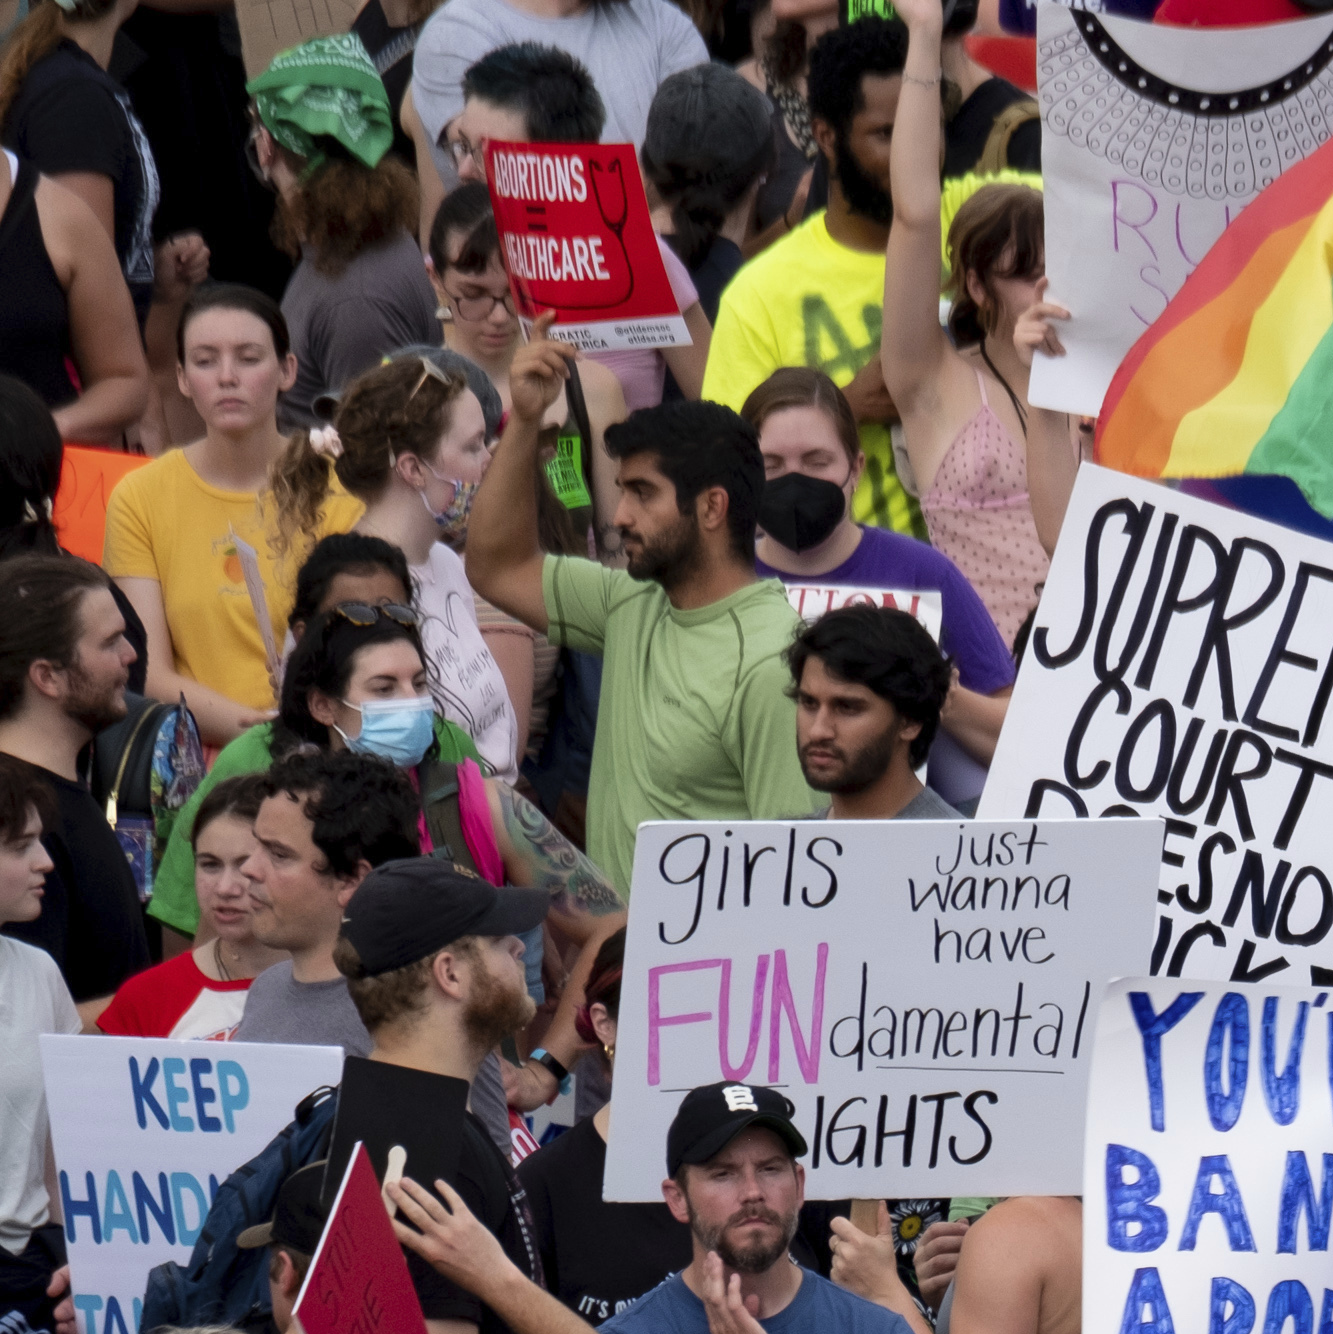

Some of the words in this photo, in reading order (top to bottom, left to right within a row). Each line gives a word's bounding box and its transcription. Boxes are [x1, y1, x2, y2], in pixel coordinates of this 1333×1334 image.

[493, 152, 588, 203] ABORTIONS
[503, 231, 611, 282] HEALTHCARE
[657, 828, 845, 946] girls
[935, 823, 1049, 876] just
[909, 871, 1071, 913] wanna
[933, 918, 1058, 965] have
[129, 1055, 250, 1134] KEEP
[786, 1090, 999, 1171] IGHTS
